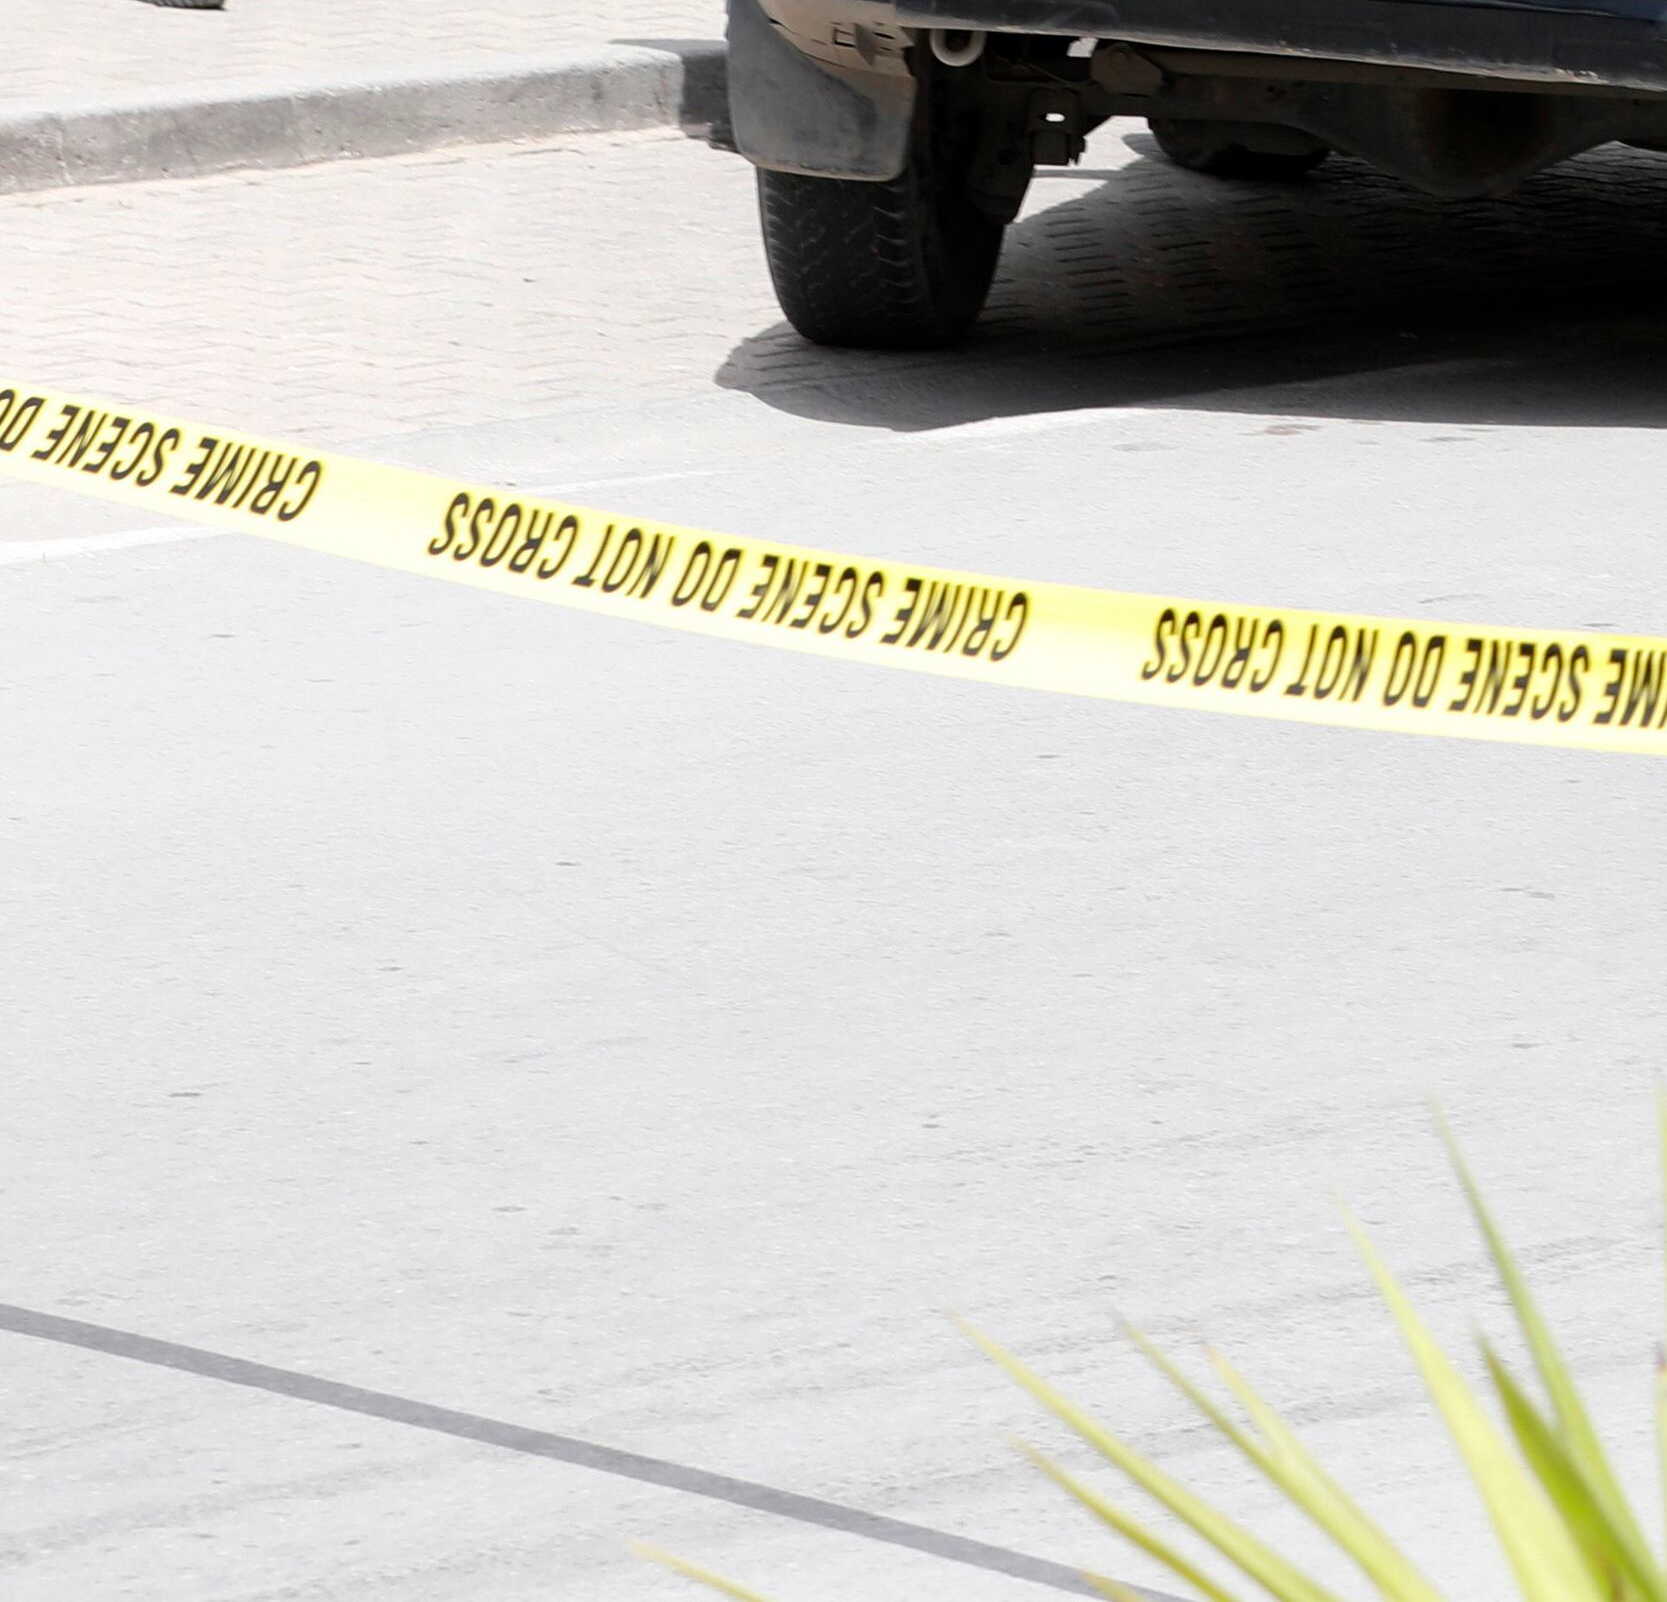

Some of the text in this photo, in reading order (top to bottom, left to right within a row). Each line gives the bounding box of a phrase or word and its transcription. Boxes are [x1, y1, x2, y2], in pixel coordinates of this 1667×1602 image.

[31, 404, 181, 488] SCENE
[169, 436, 322, 522] CRIME
[427, 491, 1029, 662] CRIME SCENE DO NOT CROSS
[1140, 607, 1284, 693] CROSS
[1283, 623, 1380, 703] NOT
[1383, 631, 1447, 709] DO
[1449, 638, 1589, 722] SCENE
